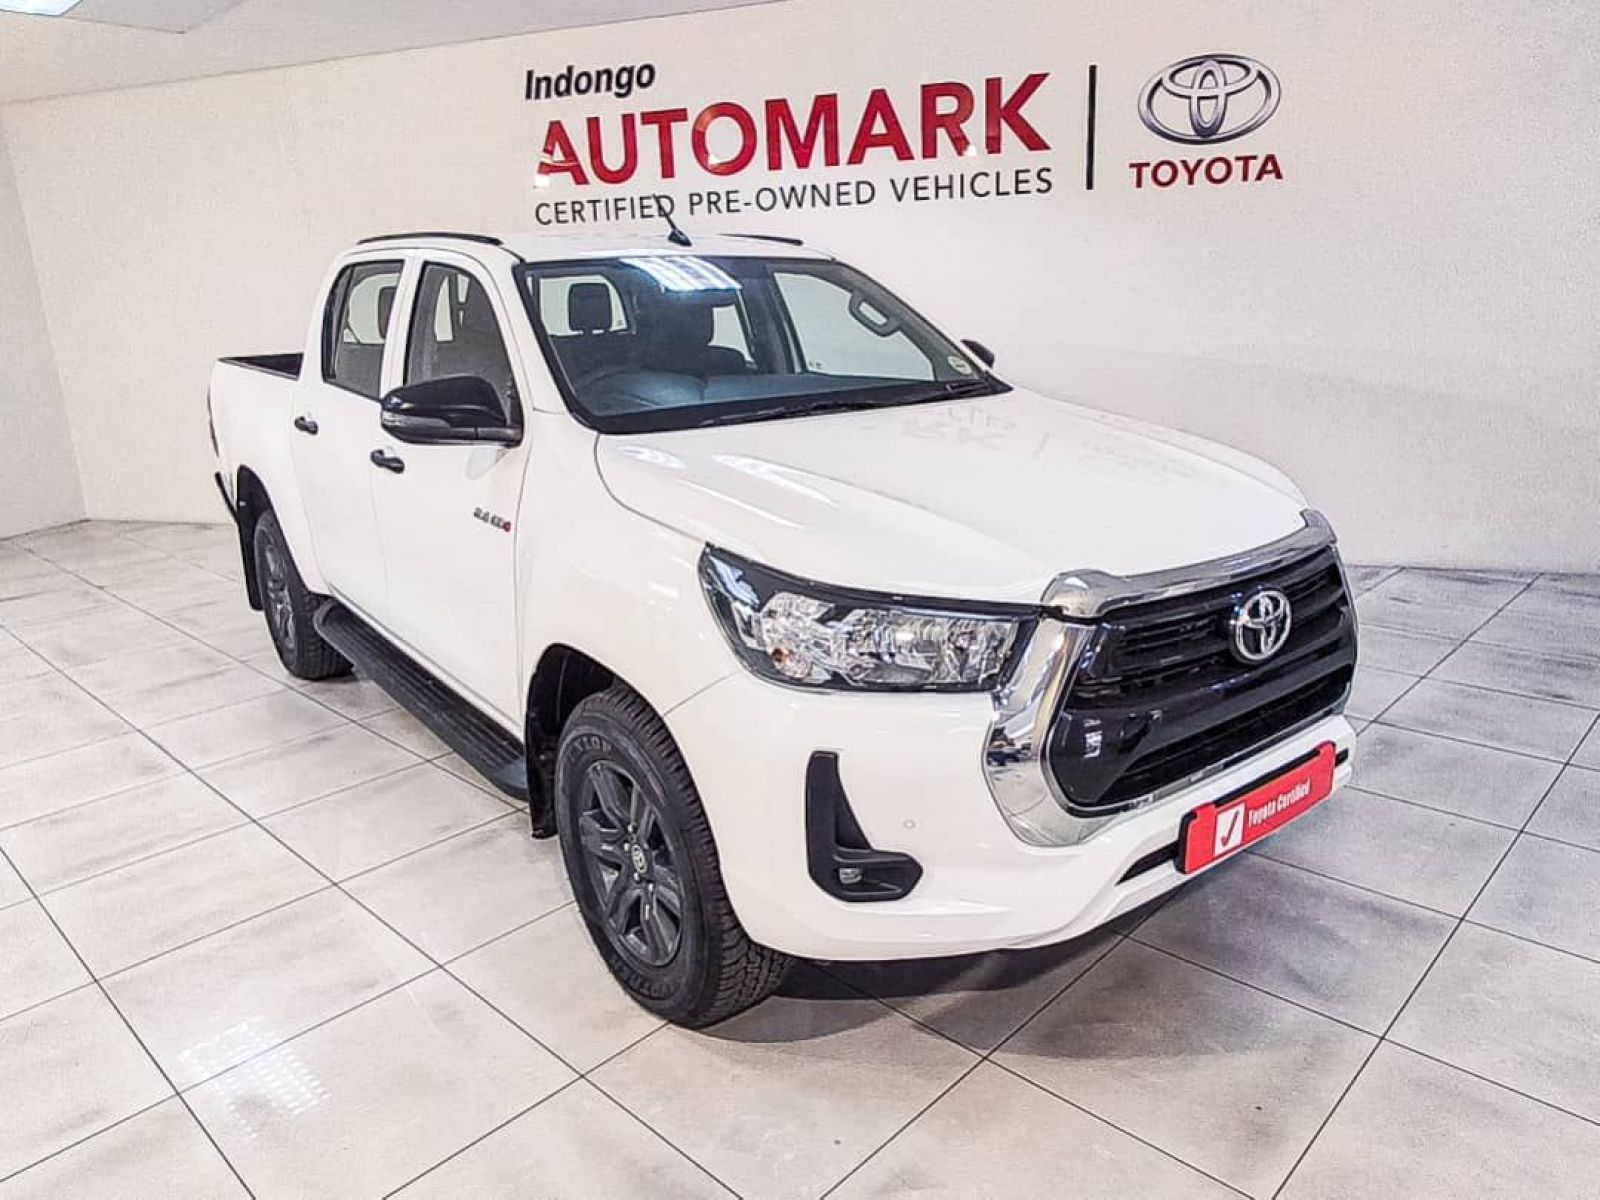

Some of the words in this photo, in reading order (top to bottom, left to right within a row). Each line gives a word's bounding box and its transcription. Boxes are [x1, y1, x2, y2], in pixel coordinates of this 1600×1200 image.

[526, 63, 655, 99] Indongo
[535, 73, 1050, 187] AUTOMARK
[1128, 154, 1283, 188] TOYOTA
[535, 196, 675, 225] CERTIFIED
[689, 182, 875, 215] PRE-OWNED
[890, 167, 1053, 201] VEHICLES
[1248, 799, 1276, 827] Toyota
